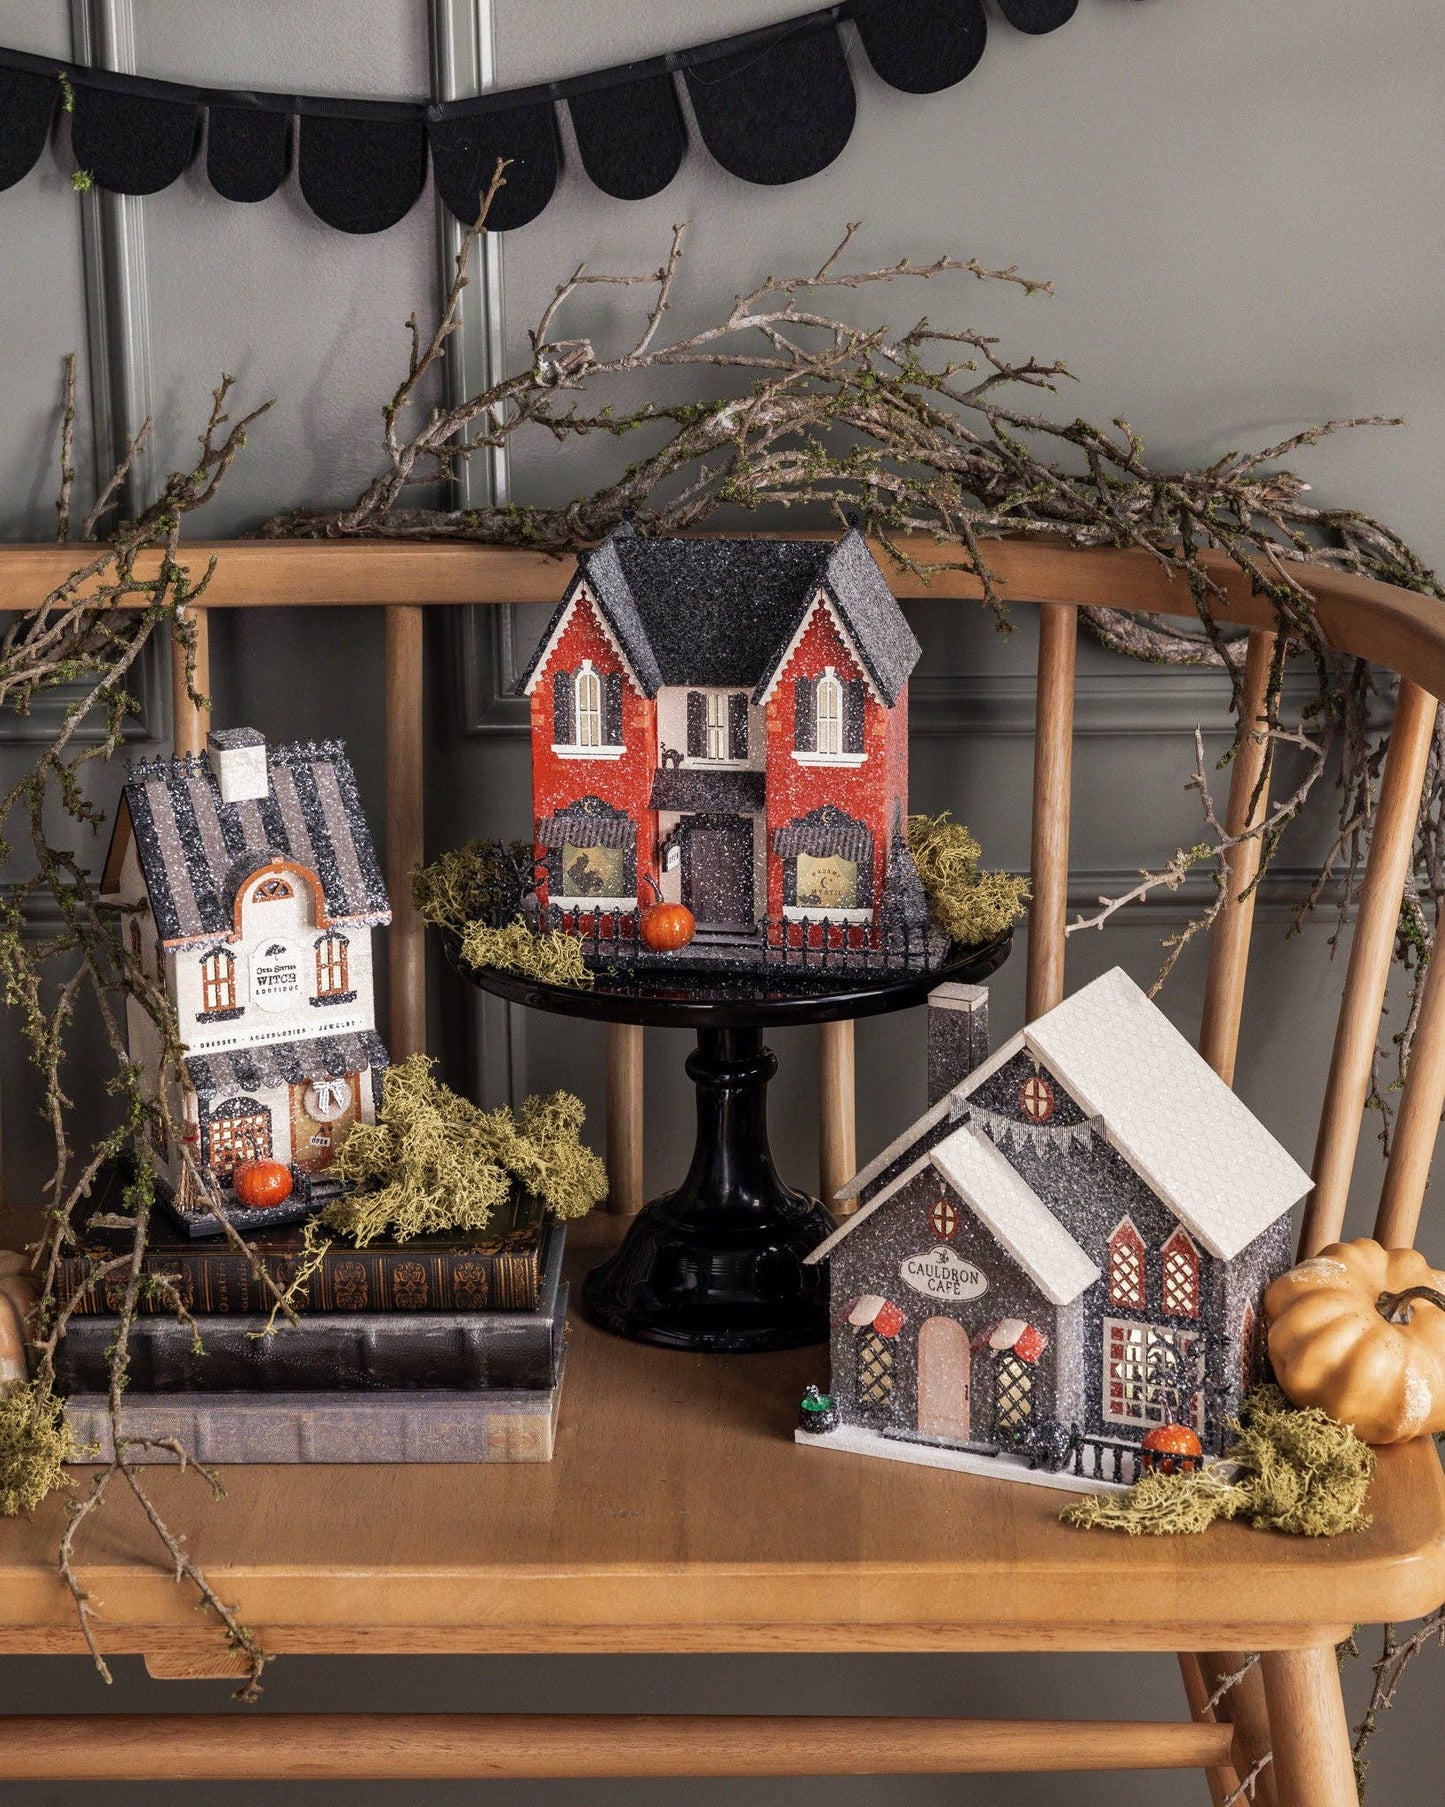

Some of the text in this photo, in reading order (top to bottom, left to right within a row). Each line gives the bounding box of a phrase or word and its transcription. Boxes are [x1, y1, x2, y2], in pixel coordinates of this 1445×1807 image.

[256, 973, 297, 986] WITCH
[255, 984, 299, 996] BOUTIQUE
[200, 1037, 237, 1049] DRESSES
[907, 1262, 979, 1284] CAULDRON
